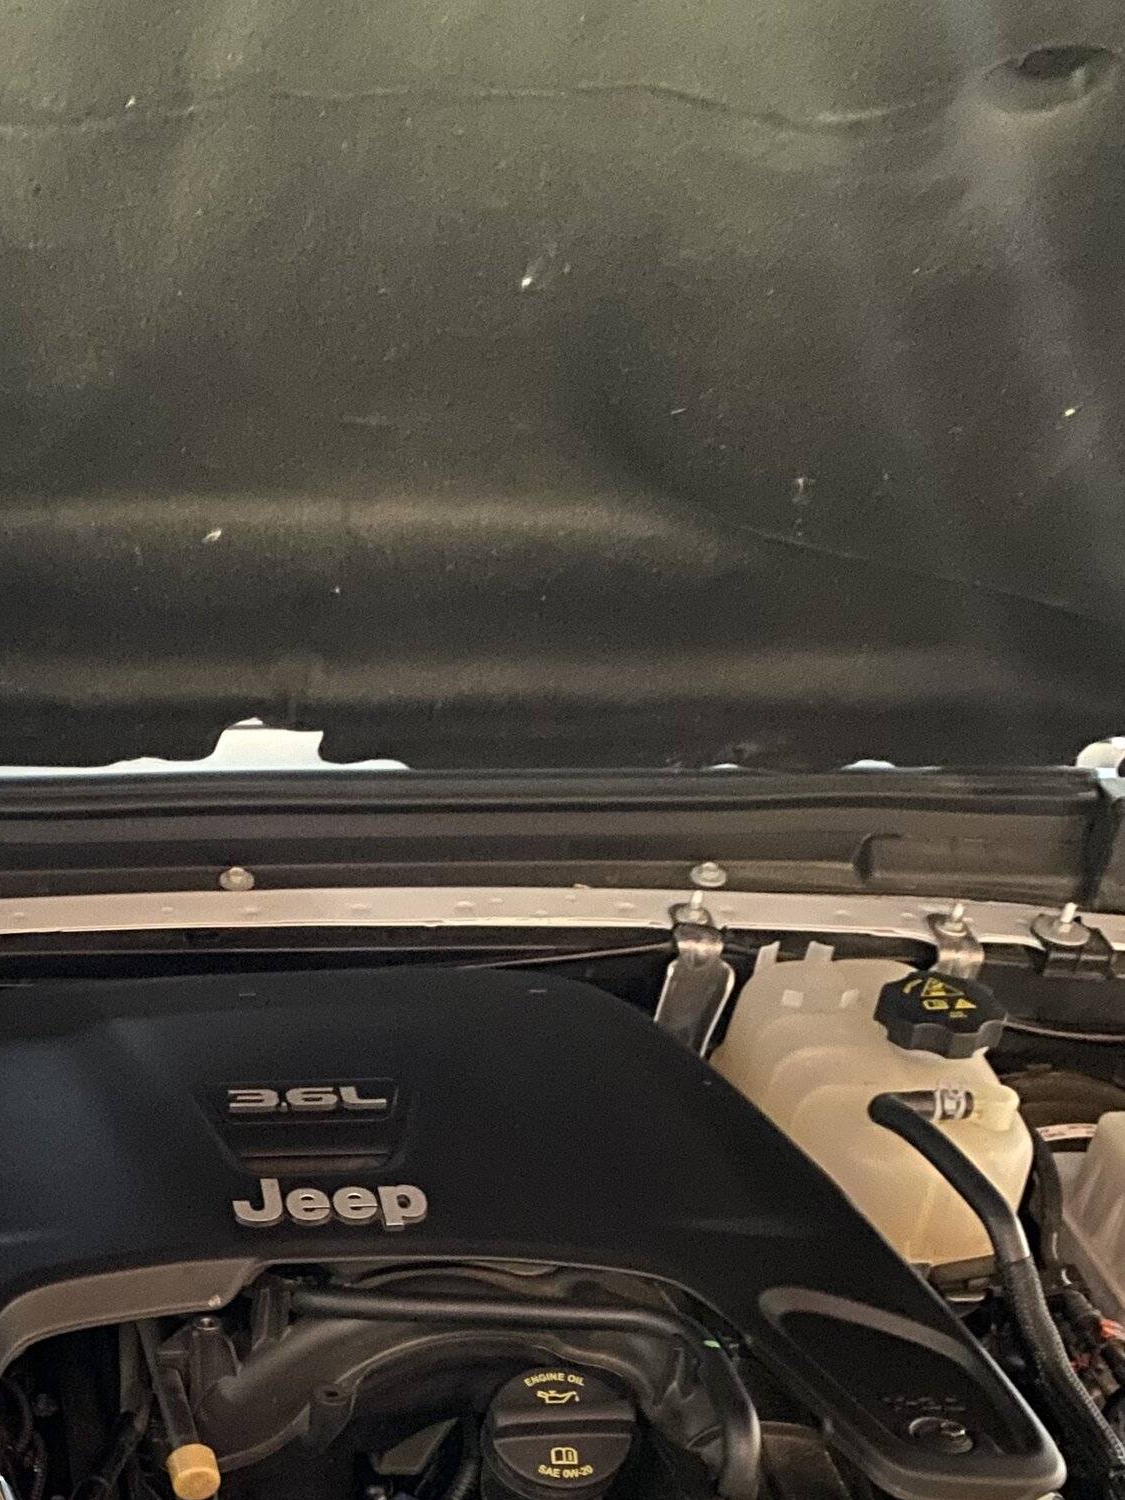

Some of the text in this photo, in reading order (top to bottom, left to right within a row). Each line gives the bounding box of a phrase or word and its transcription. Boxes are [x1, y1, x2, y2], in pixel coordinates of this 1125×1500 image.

[228, 1086, 387, 1112] 3.6L
[232, 1178, 428, 1232] Jeep
[523, 1372, 585, 1387] ENGINE OIL
[538, 1464, 594, 1478] SAE 0W-20
